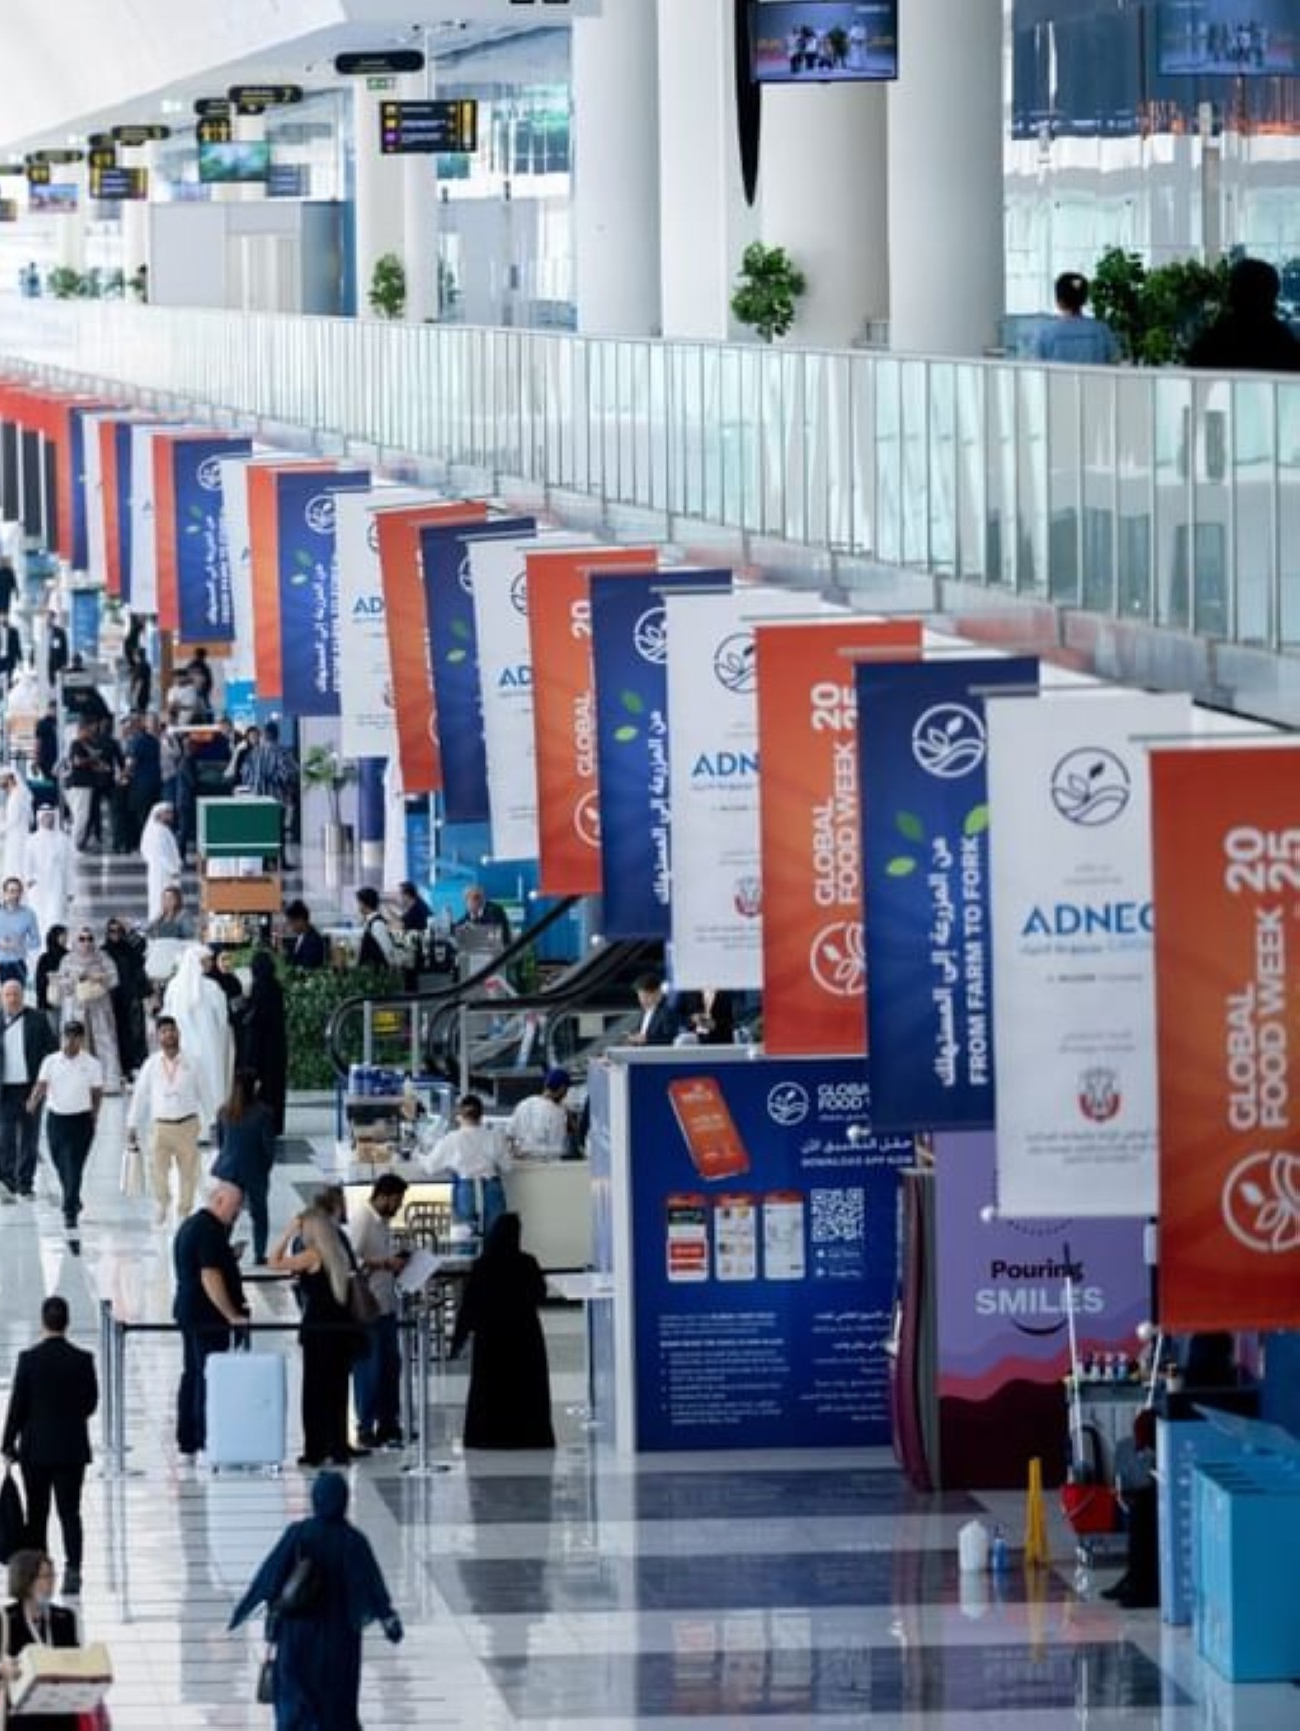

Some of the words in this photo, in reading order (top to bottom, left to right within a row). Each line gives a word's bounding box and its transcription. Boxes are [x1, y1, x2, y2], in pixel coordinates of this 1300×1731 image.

[571, 600, 593, 639] 20
[574, 691, 597, 778] GLOBAL
[810, 681, 842, 731] 20
[691, 752, 759, 778] ADN
[833, 739, 858, 824] WEEK
[812, 797, 835, 906] GLOBAL
[836, 827, 862, 906] FOOD
[931, 836, 954, 868] من
[960, 834, 982, 900] FORK
[1223, 825, 1266, 893] 20
[1266, 826, 1300, 893] 25
[963, 903, 983, 938] TO
[964, 941, 984, 1011] FARM
[1256, 905, 1285, 1018] WEEK
[967, 1014, 988, 1087] FROM
[1226, 982, 1257, 1132] GLOBAL
[1257, 1020, 1288, 1130] FOOD
[817, 1083, 870, 1096] GLOBA
[974, 1286, 1105, 1315] SMILES
[990, 1258, 1084, 1283] Pouring
